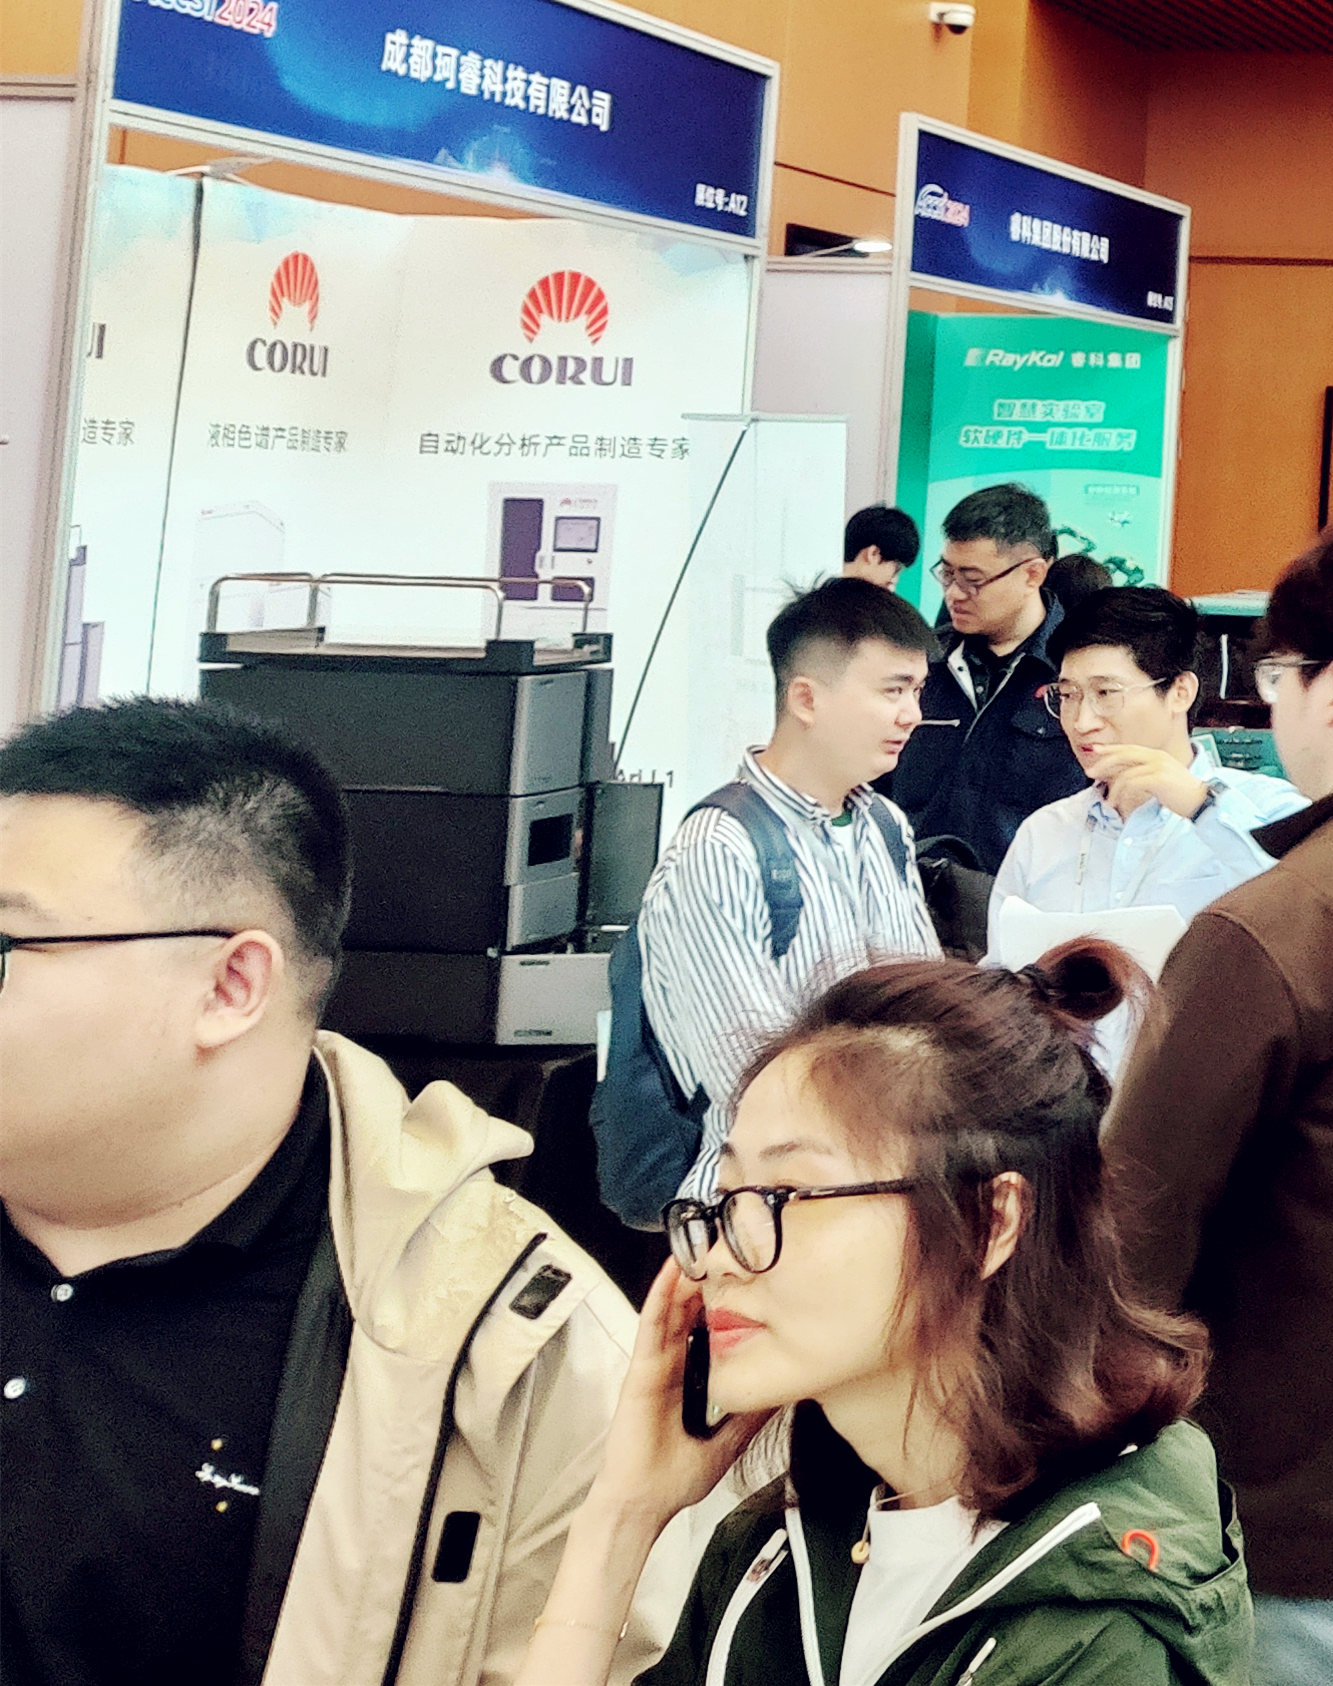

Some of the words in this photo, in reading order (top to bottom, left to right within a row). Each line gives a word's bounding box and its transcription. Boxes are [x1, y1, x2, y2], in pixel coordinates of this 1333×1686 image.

[381, 28, 612, 132] 成都珂睿科技有限公司
[246, 337, 329, 378] CORUI
[489, 353, 635, 387] CORUI
[207, 422, 349, 453] 液相色谱产品制造专家
[418, 432, 691, 460] 自动化分析产品制造专家
